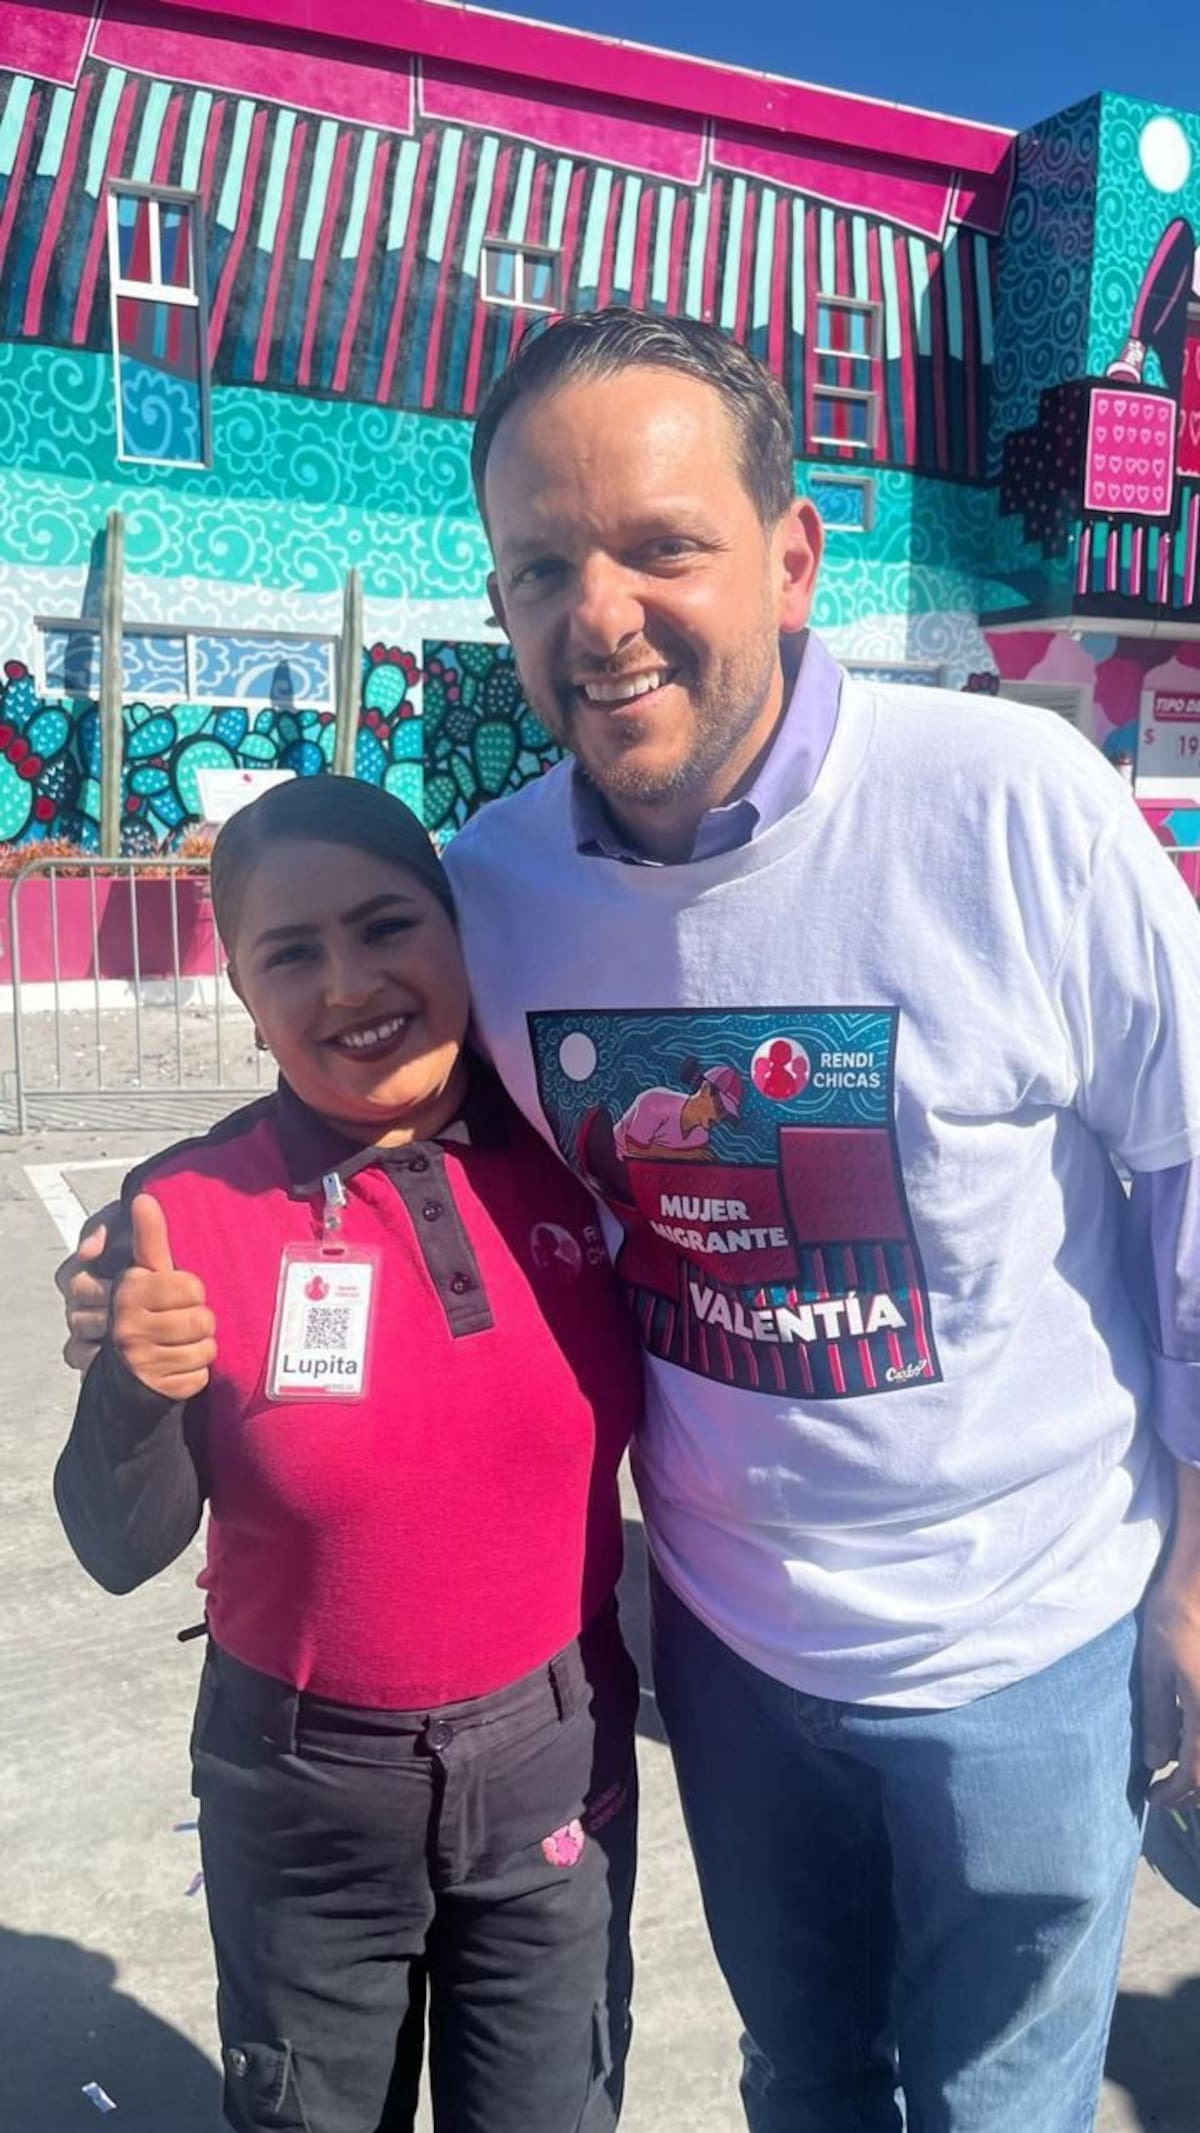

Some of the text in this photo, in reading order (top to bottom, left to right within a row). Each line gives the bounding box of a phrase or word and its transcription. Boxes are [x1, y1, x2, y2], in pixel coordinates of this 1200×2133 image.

[820, 1052, 874, 1068] RENDI
[812, 1072, 881, 1088] CHICAS
[660, 1194, 750, 1222] MUJER
[689, 1281, 907, 1343] VALENTÍA
[283, 1354, 358, 1379] Lupita
